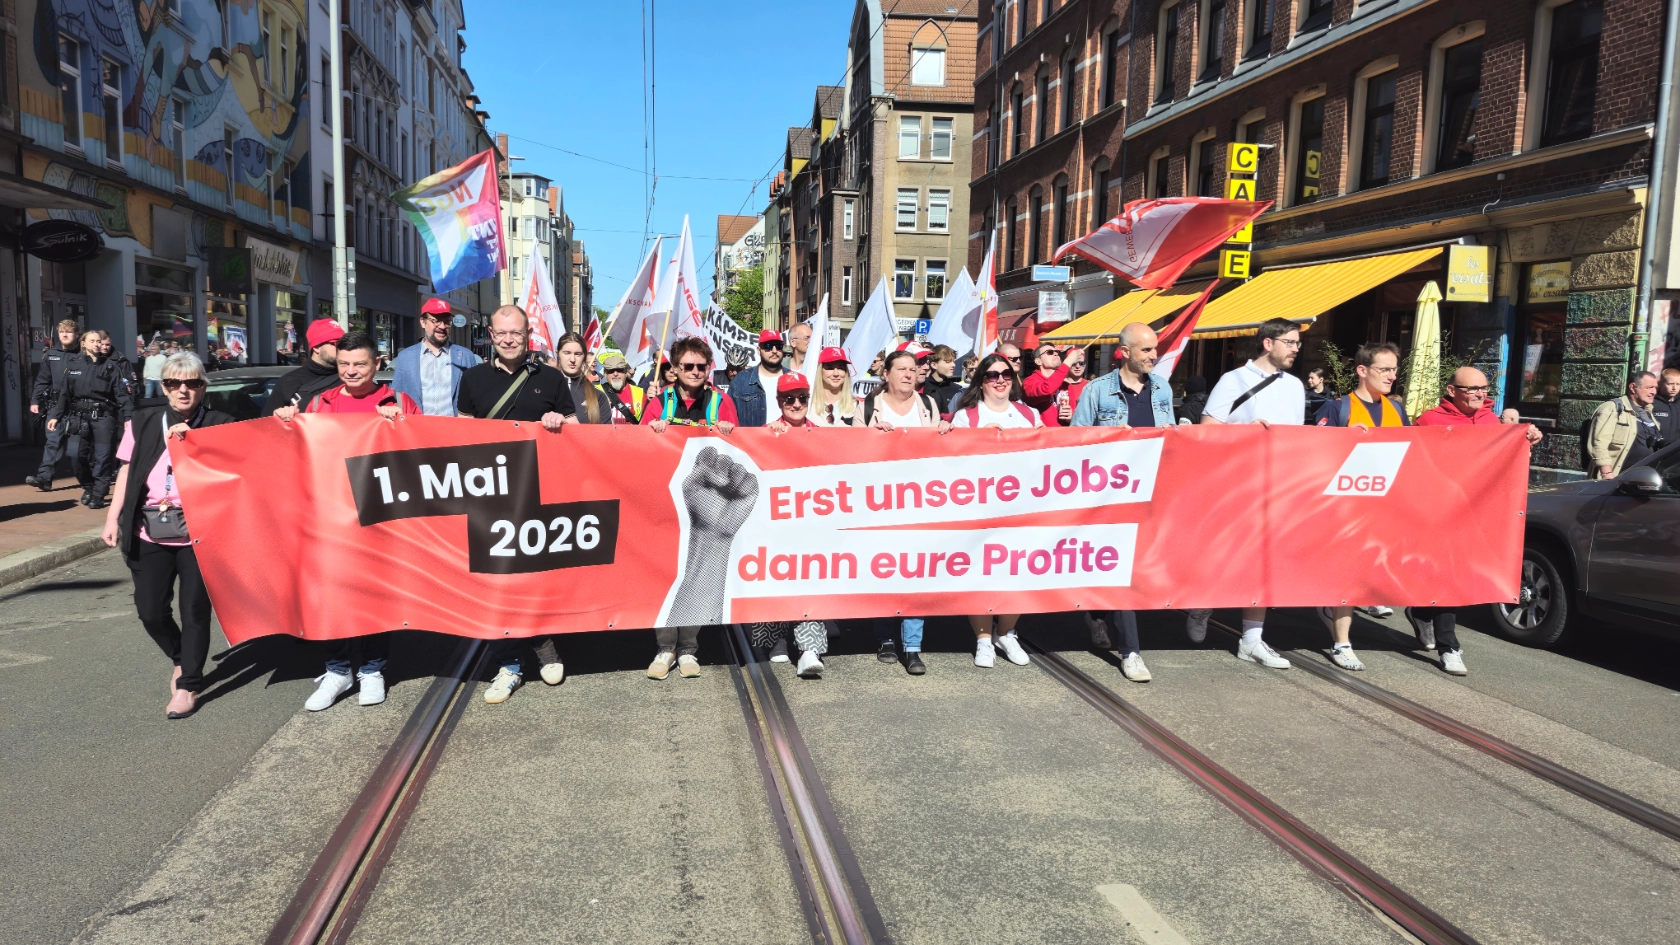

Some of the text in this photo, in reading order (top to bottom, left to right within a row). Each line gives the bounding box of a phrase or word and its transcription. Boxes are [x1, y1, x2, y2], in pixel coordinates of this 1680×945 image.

[34, 330, 43, 342] 83
[707, 306, 760, 345] KÄMPF
[919, 321, 927, 333] P
[373, 454, 509, 505] 1. Mai
[769, 458, 1141, 520] Erst unsere Jobs,
[1337, 475, 1386, 492] DGB
[489, 514, 601, 557] 2026
[738, 538, 1119, 581] dann eure Profite
